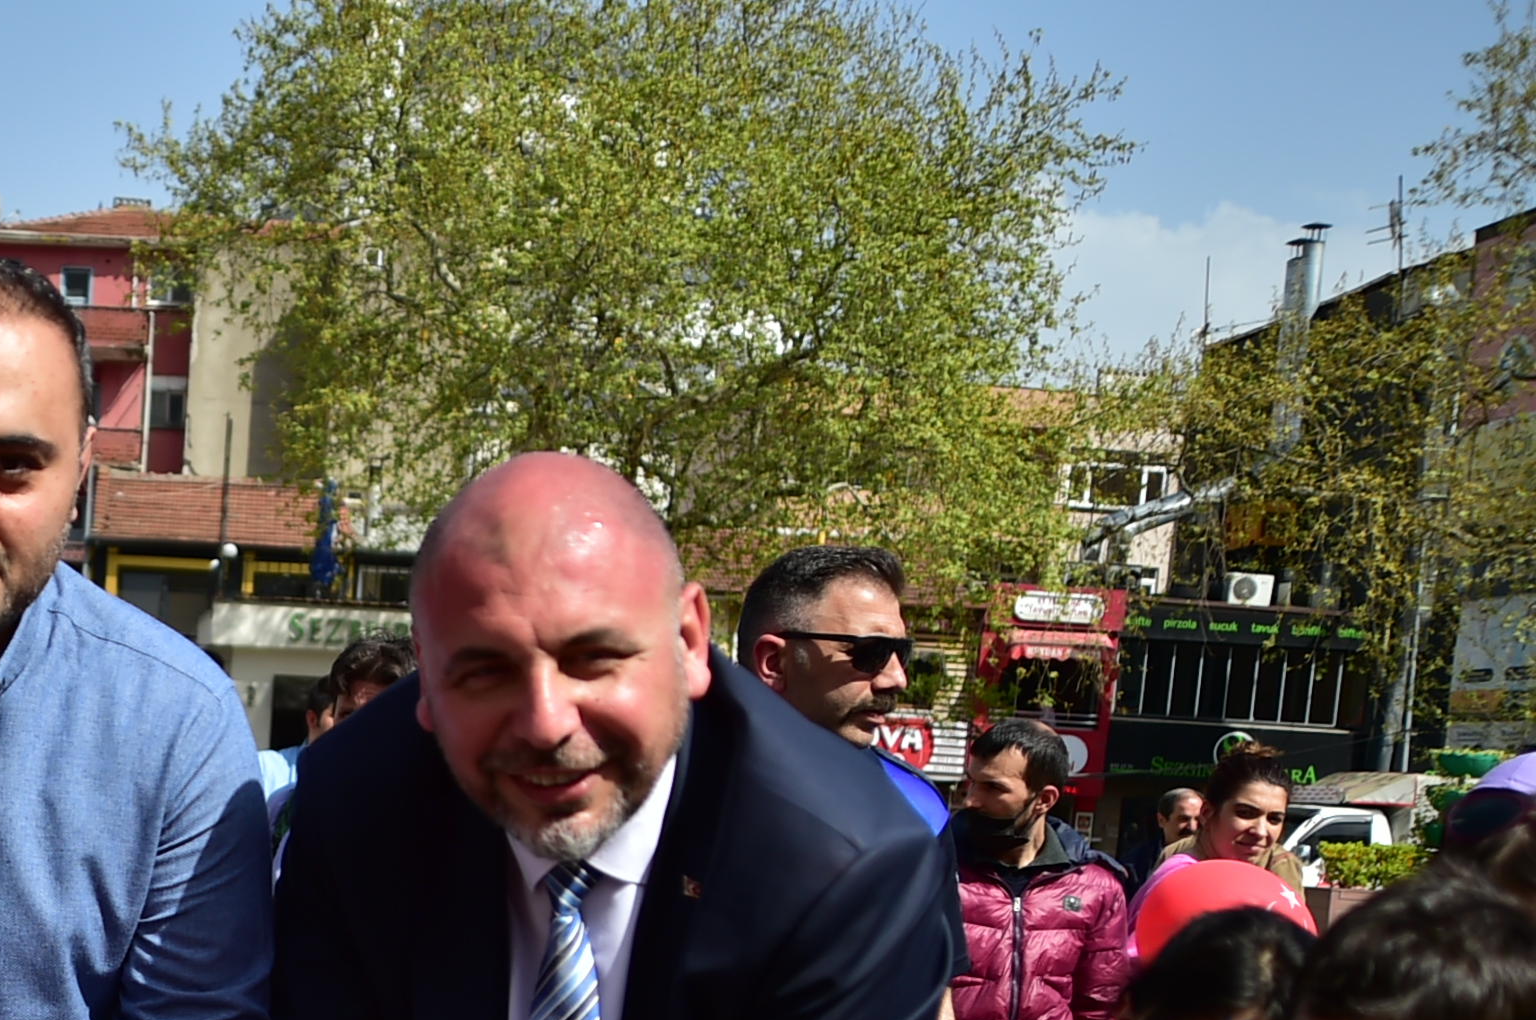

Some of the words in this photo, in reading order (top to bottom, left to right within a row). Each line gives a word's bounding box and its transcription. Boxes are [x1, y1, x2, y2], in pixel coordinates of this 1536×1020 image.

[1163, 618, 1198, 631] pirzola
[1209, 622, 1238, 633] sucuk
[1251, 623, 1280, 635] tavuk
